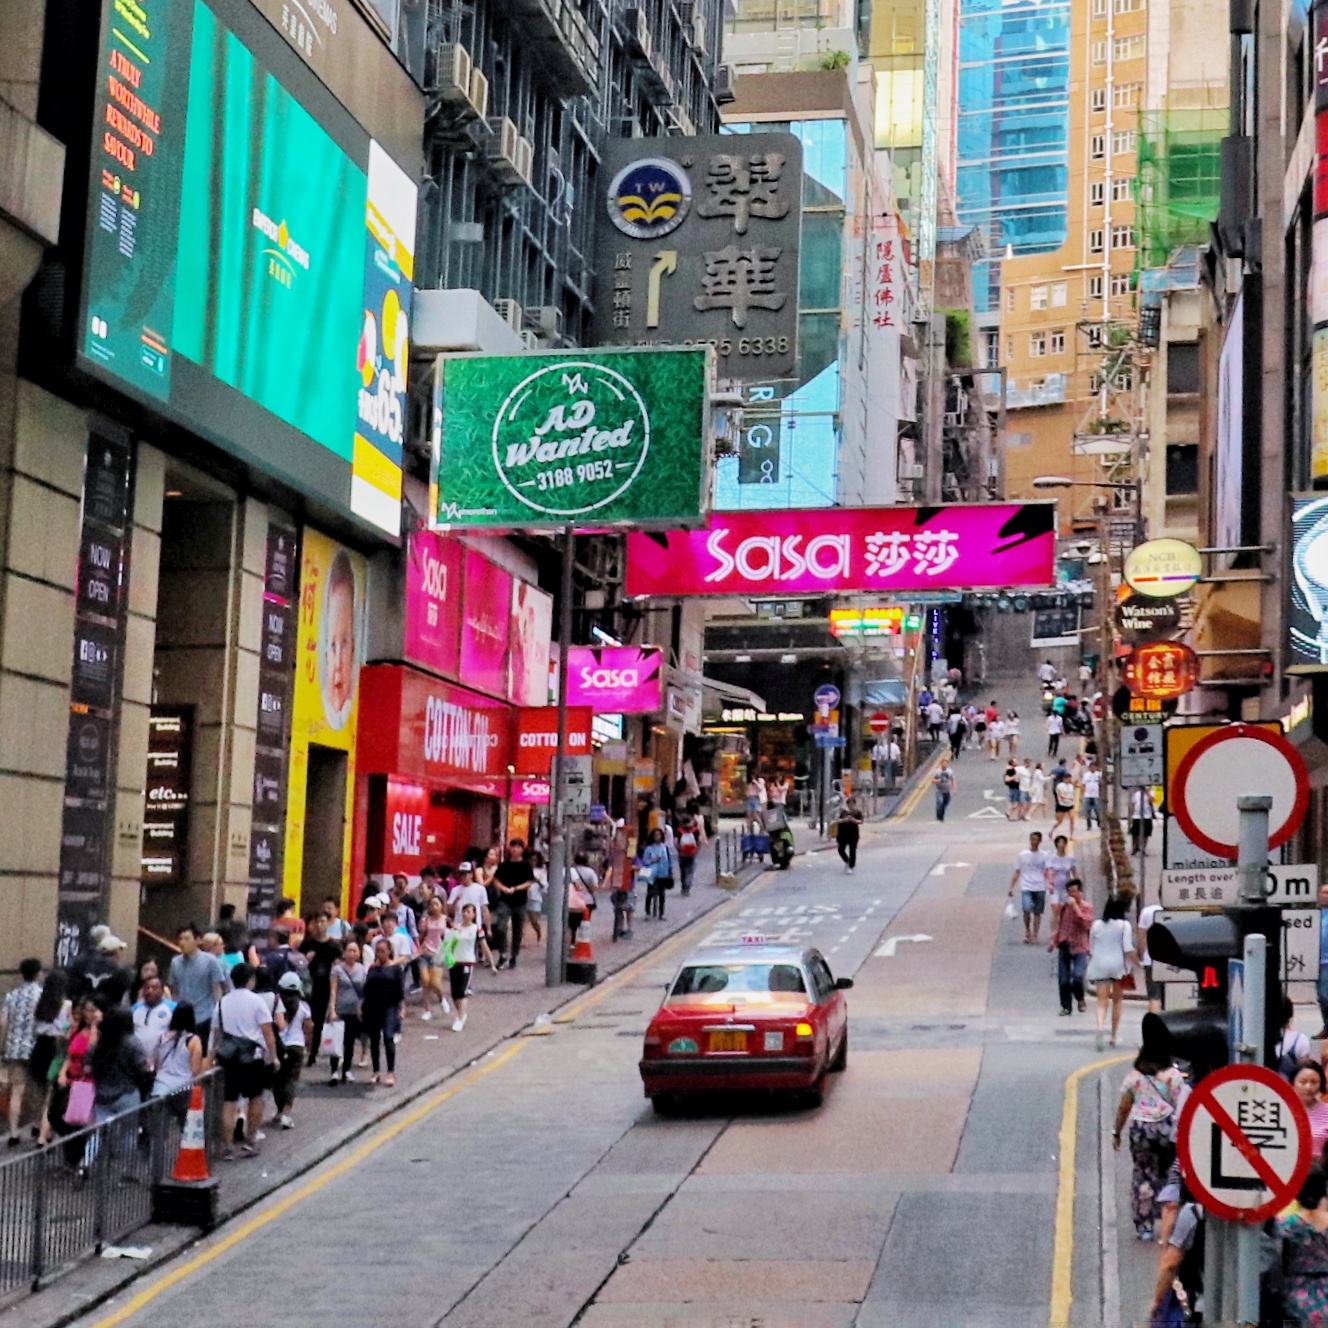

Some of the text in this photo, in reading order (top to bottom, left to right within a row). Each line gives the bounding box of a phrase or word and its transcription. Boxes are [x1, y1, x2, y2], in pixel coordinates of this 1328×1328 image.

[738, 336, 789, 356] 6338
[534, 400, 596, 436] AD
[505, 420, 636, 468] Wanted
[536, 459, 615, 491] 3188 9052
[90, 543, 112, 569] NOW
[704, 528, 960, 583] Sasa 莎莎
[1149, 552, 1176, 561] NCB
[421, 547, 448, 602] Sasa
[88, 579, 110, 603] OPEN
[1121, 604, 1175, 617] Watson's
[1121, 617, 1154, 629] Wine
[580, 666, 639, 689] Sasa
[1121, 712, 1169, 720] CENTURY
[424, 695, 489, 773] COTTON ON
[519, 732, 587, 747] COTTO ON
[522, 782, 550, 797] Sas
[392, 811, 422, 857] SALE
[1172, 859, 1231, 869] midnigh
[1168, 873, 1206, 885] Length
[1210, 875, 1234, 883] over
